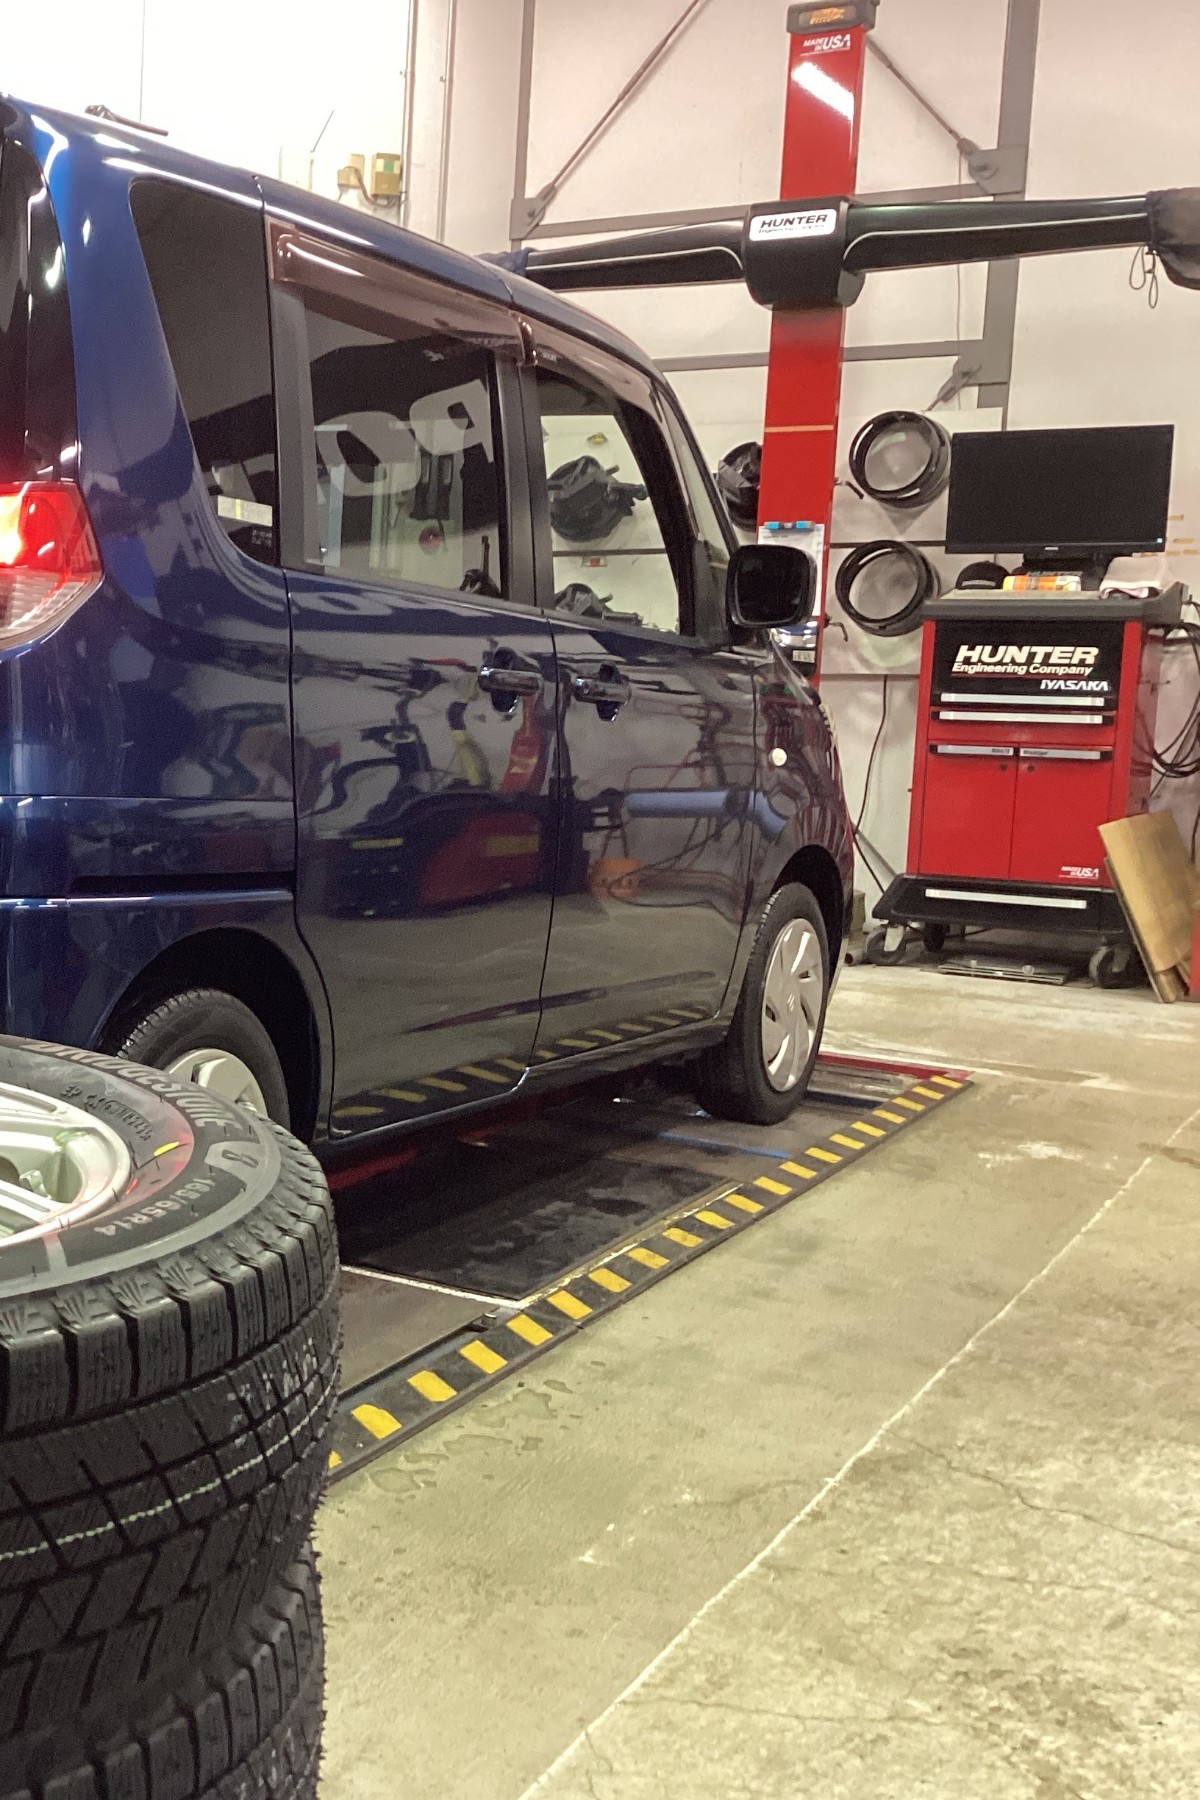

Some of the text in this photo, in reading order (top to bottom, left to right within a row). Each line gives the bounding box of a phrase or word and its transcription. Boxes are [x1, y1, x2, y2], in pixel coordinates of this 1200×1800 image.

[822, 33, 851, 50] USA
[760, 214, 828, 229] HUNTER
[955, 644, 1099, 665] HUNTER
[952, 662, 1094, 676] Engineering Company
[1040, 679, 1109, 692] IYASAKA
[1077, 867, 1099, 878] USA
[93, 1177, 217, 1237] 165/65R14
